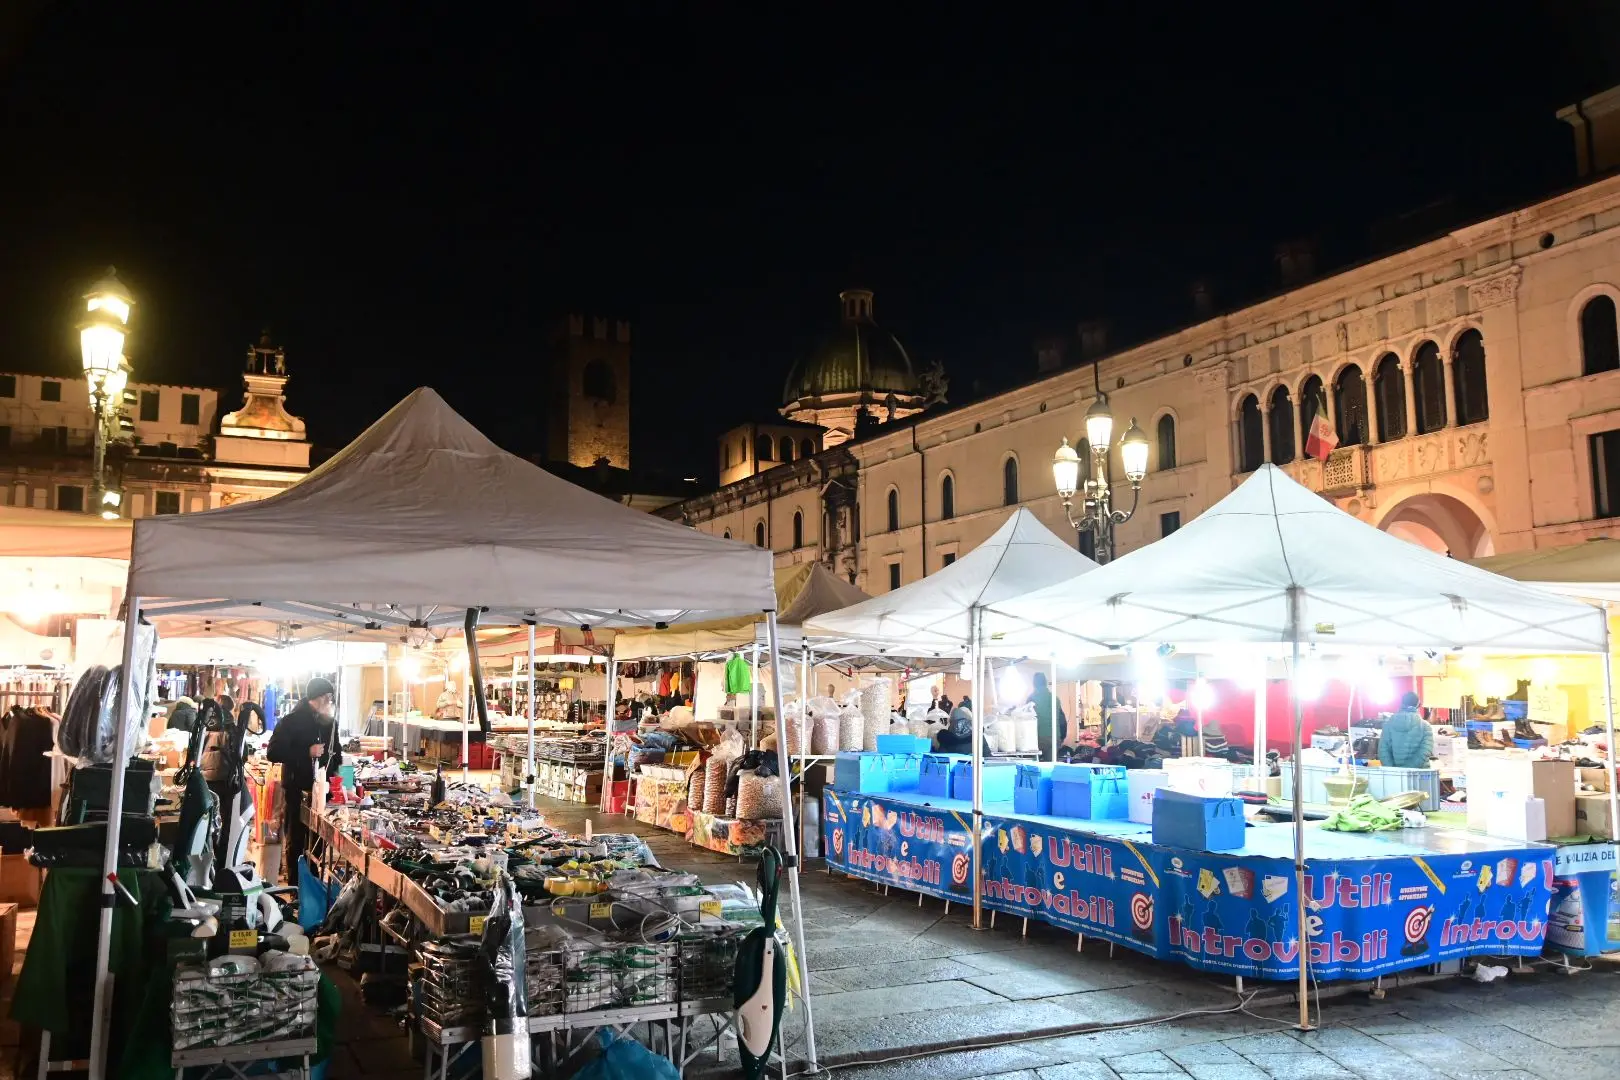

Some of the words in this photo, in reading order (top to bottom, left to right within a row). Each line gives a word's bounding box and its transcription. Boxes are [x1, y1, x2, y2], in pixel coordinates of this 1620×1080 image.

[900, 811, 944, 844] Utili
[848, 842, 940, 885] Introvabili
[901, 841, 909, 856] e
[1048, 836, 1112, 877] Utili
[1053, 871, 1065, 890] e
[1303, 873, 1392, 909] Utili
[981, 871, 1115, 928] Introvabili
[1168, 916, 1388, 964] Introvabili
[1305, 915, 1323, 936] e
[1440, 917, 1548, 946] Introv
